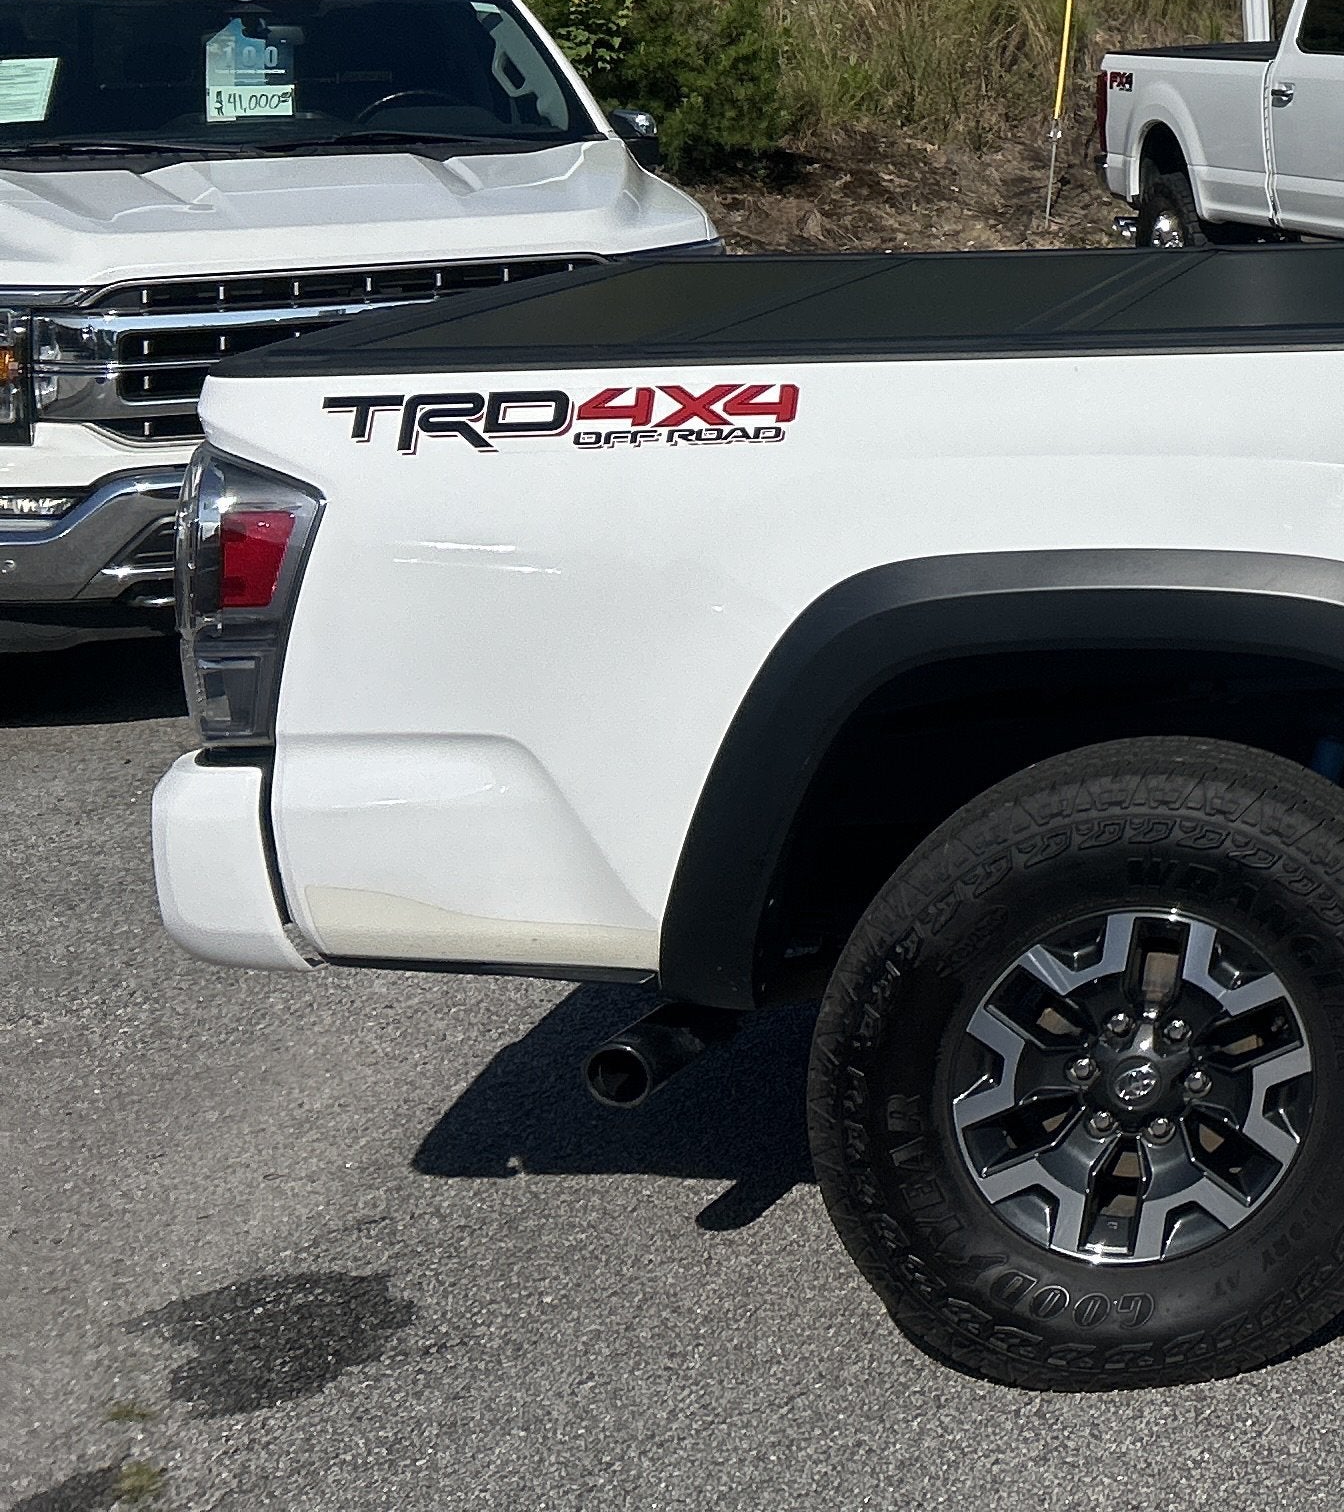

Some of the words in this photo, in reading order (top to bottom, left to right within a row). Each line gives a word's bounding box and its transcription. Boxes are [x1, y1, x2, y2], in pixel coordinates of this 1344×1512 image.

[1109, 71, 1134, 90] FX4
[322, 390, 573, 454] TRD
[575, 383, 800, 427] 4X4
[573, 428, 662, 449] OFF
[666, 425, 787, 445] ROAD
